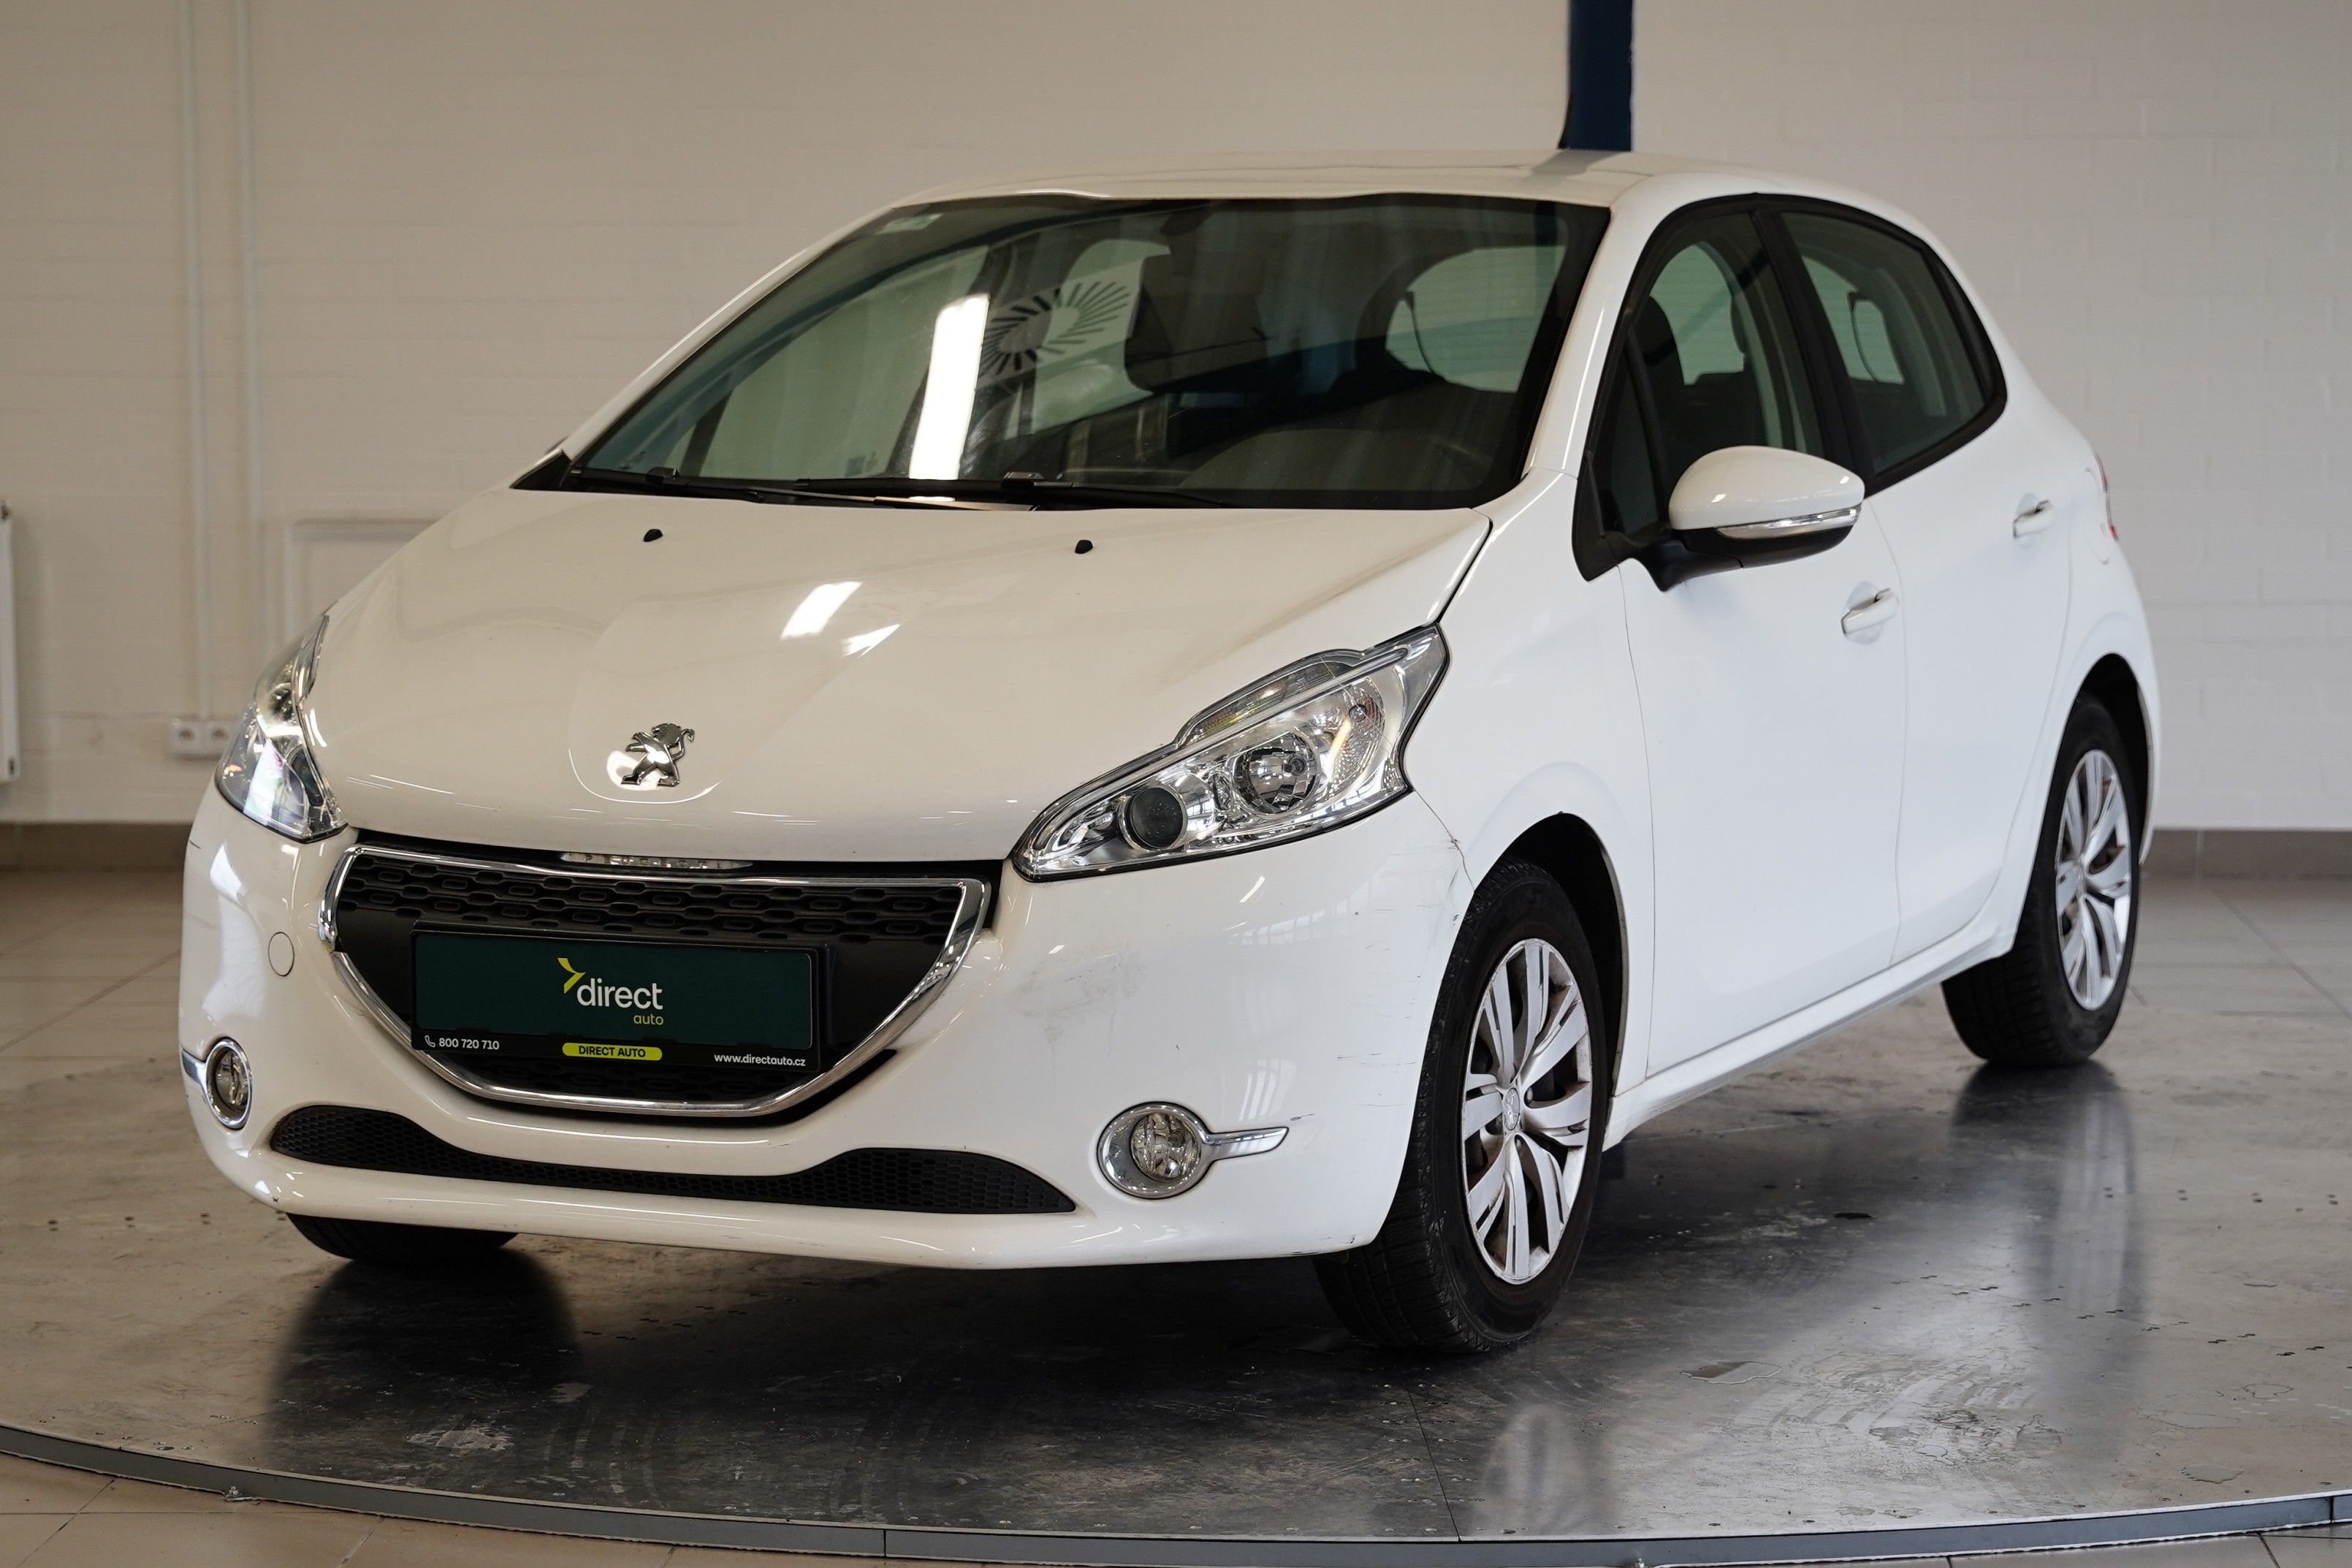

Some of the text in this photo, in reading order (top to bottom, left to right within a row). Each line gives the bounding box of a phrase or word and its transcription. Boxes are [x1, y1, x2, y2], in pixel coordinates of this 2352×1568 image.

[576, 978, 663, 1010] direct
[633, 1013, 664, 1025] auto
[438, 1038, 500, 1051] 800 720 710
[578, 1046, 646, 1058] DIRECT AUTO
[714, 1054, 806, 1067] www.directauto.cz
